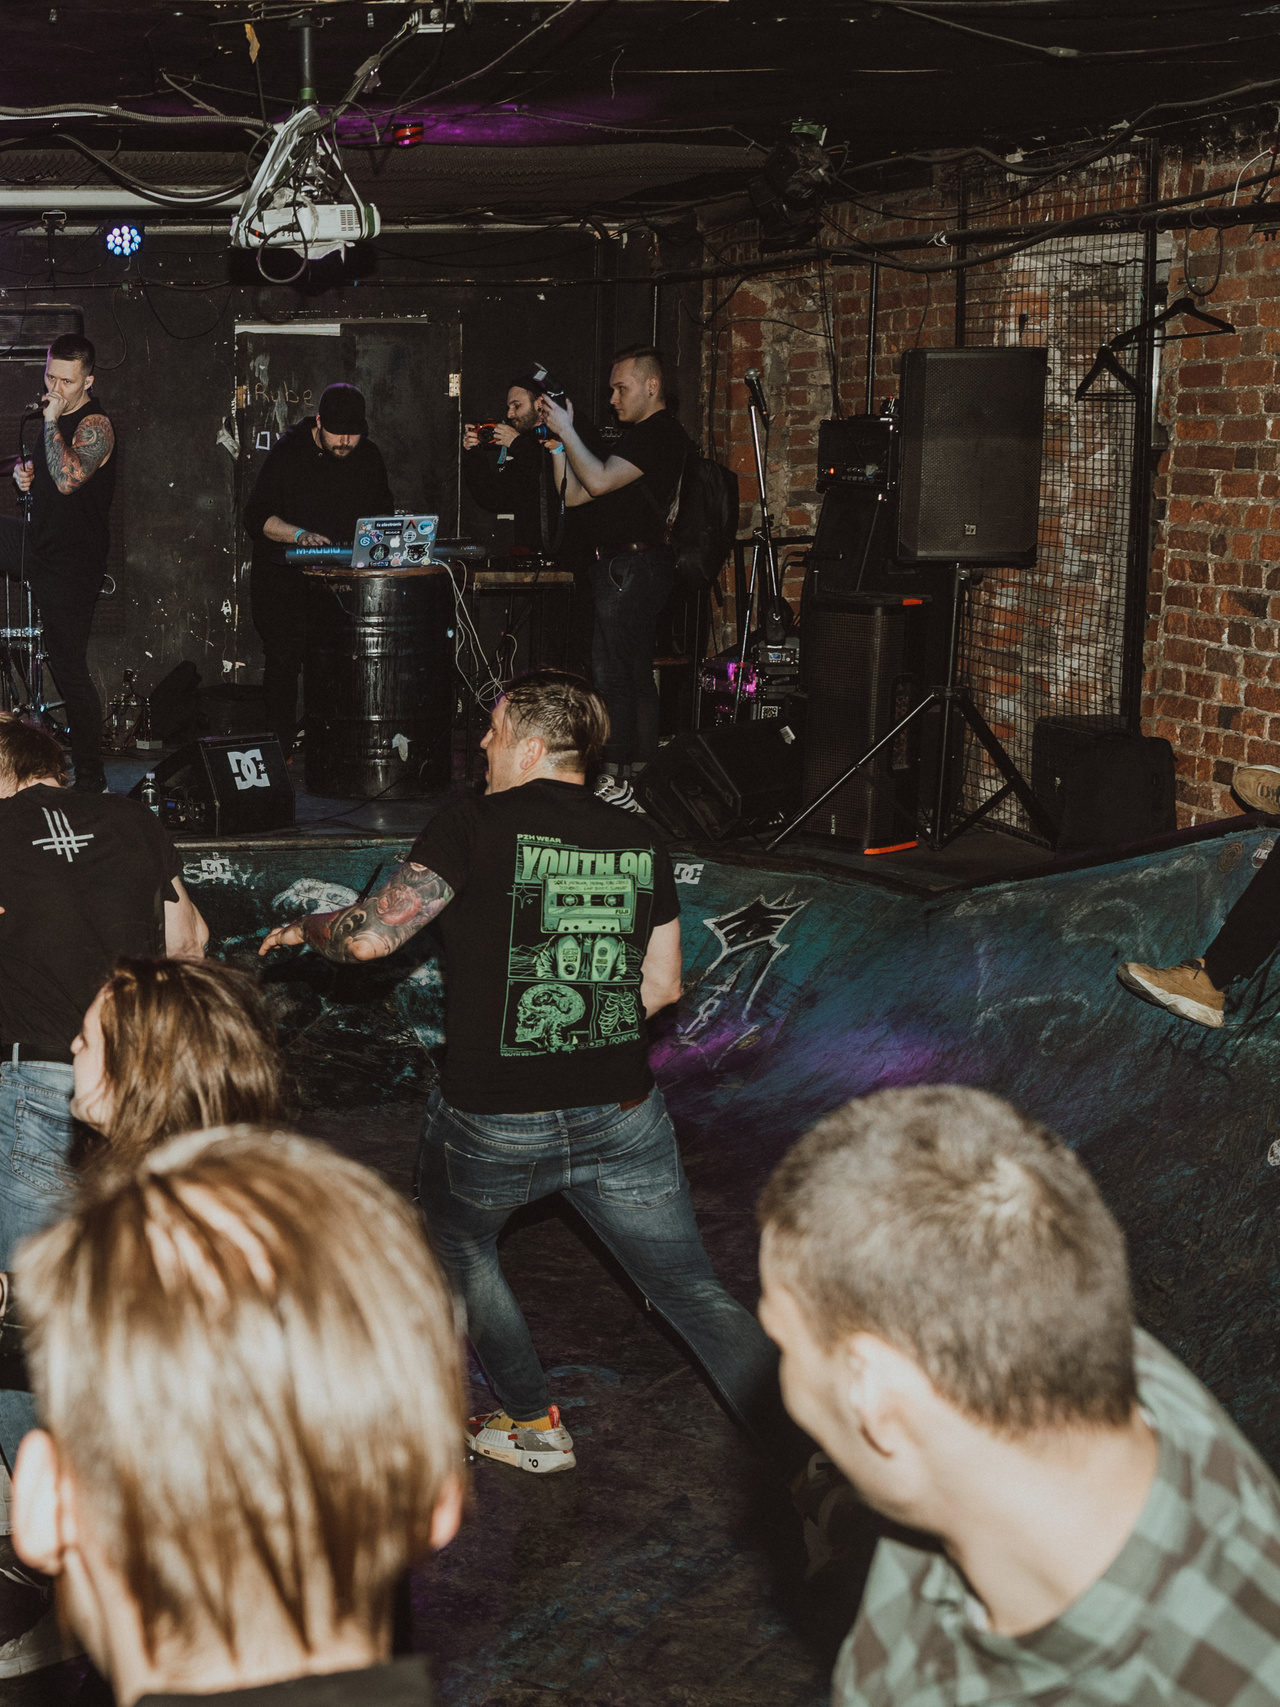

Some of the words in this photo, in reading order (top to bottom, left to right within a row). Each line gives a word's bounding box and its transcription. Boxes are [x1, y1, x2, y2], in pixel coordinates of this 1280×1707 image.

[296, 547, 341, 555] M-AUDIO
[227, 748, 271, 790] DC
[517, 833, 535, 841] PZH
[536, 835, 562, 844] WEAR
[521, 846, 616, 881] YOUTH
[619, 851, 652, 886] 90
[673, 862, 705, 885] DC
